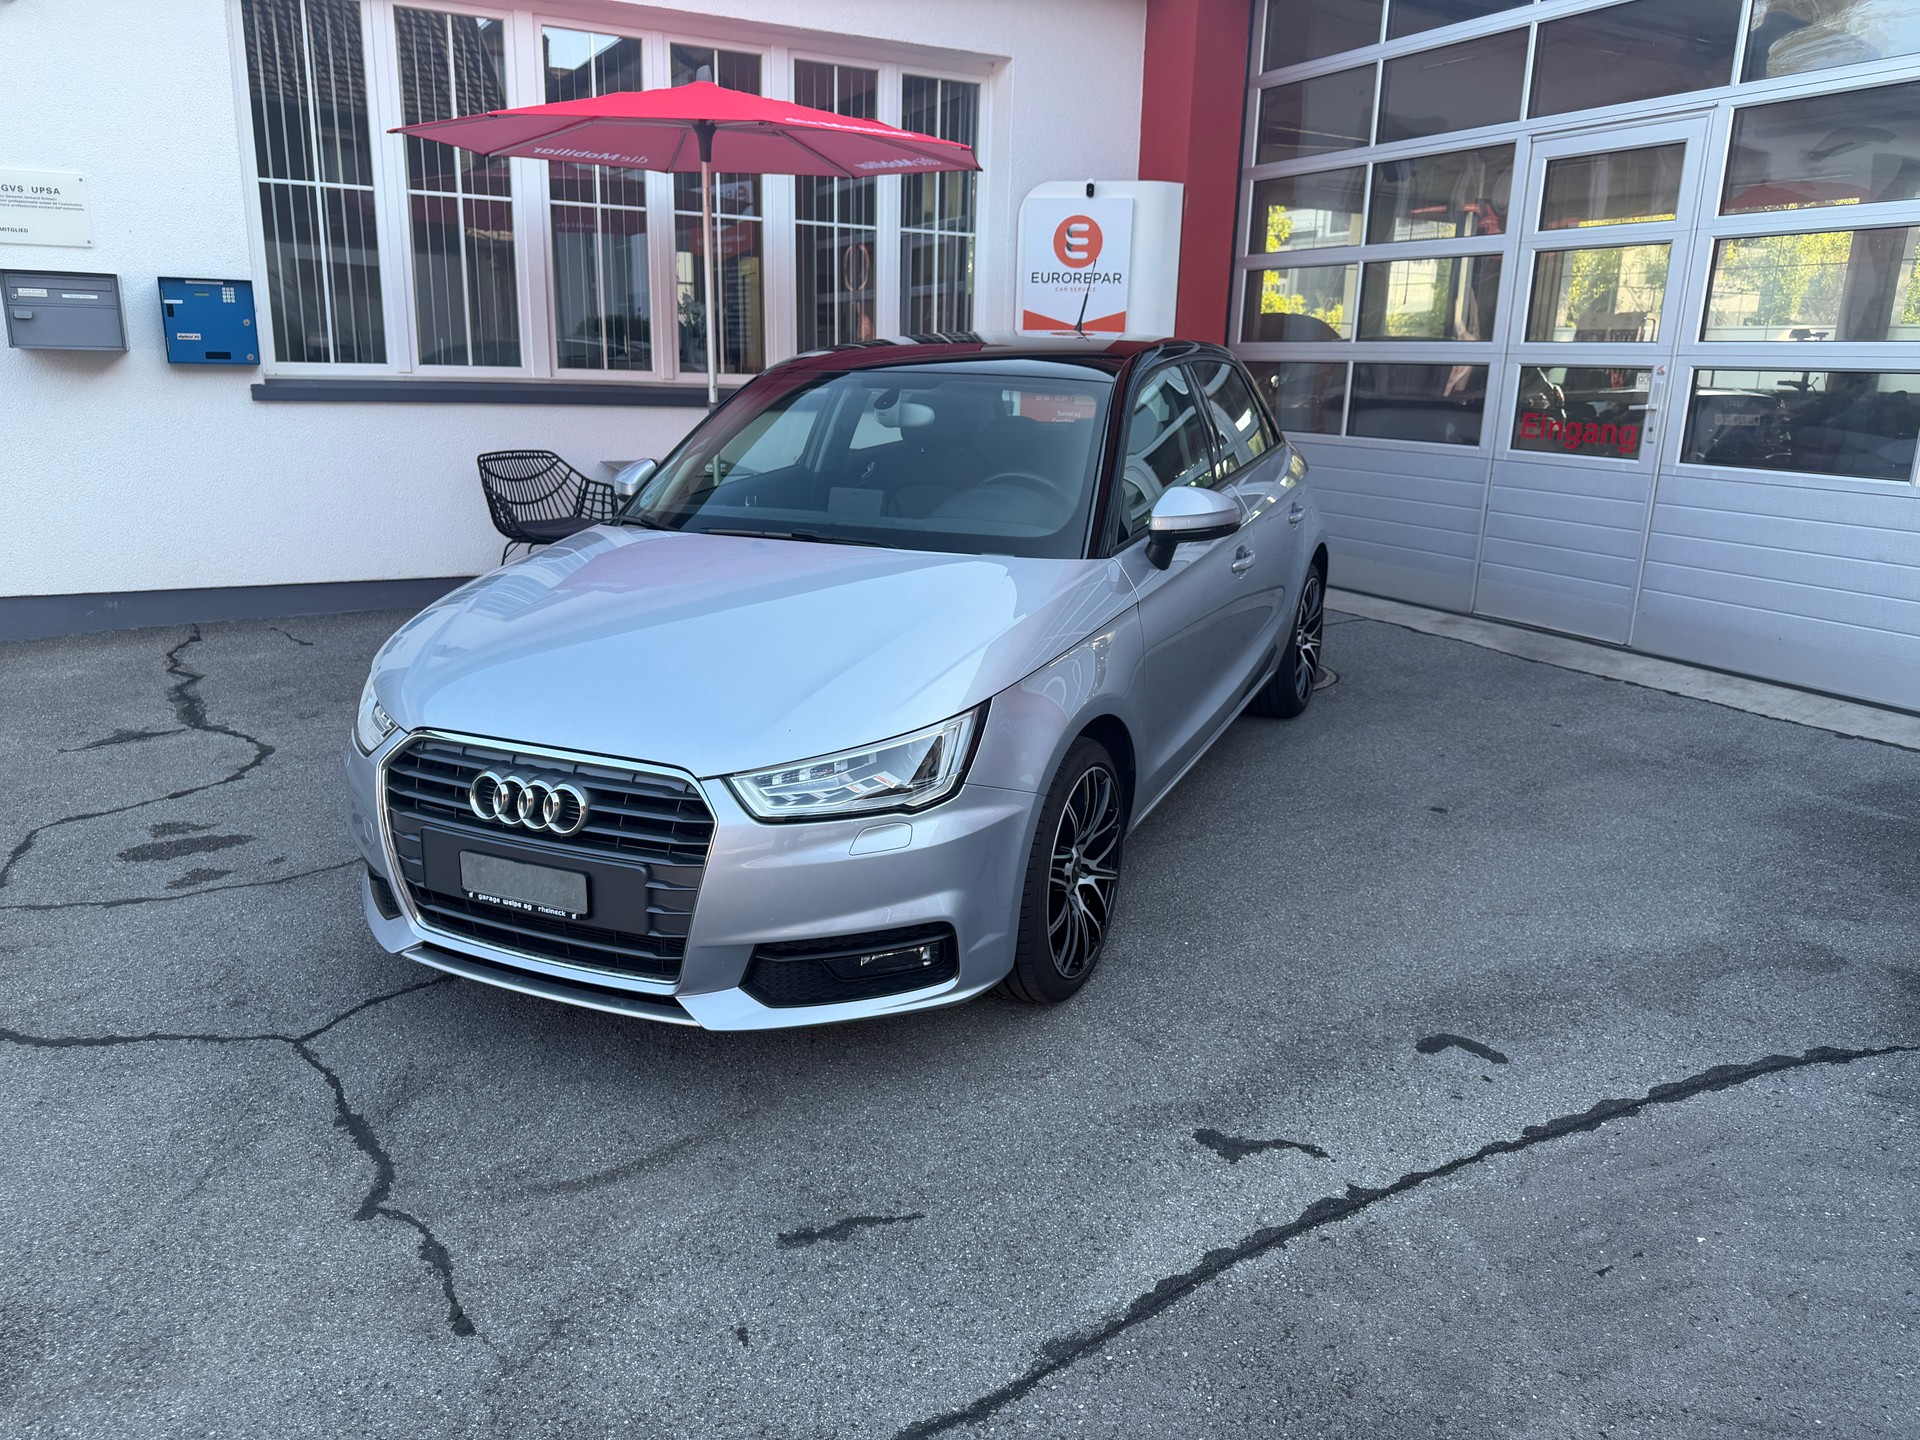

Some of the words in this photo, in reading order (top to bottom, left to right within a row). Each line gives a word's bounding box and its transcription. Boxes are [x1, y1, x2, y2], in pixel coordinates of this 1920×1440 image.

[31, 186, 60, 195] UPSA
[1031, 271, 1122, 284] EUROREPAR
[1520, 412, 1638, 453] Eingang
[478, 894, 500, 903] garage
[523, 903, 532, 911] ag
[538, 906, 566, 916] rheineck
